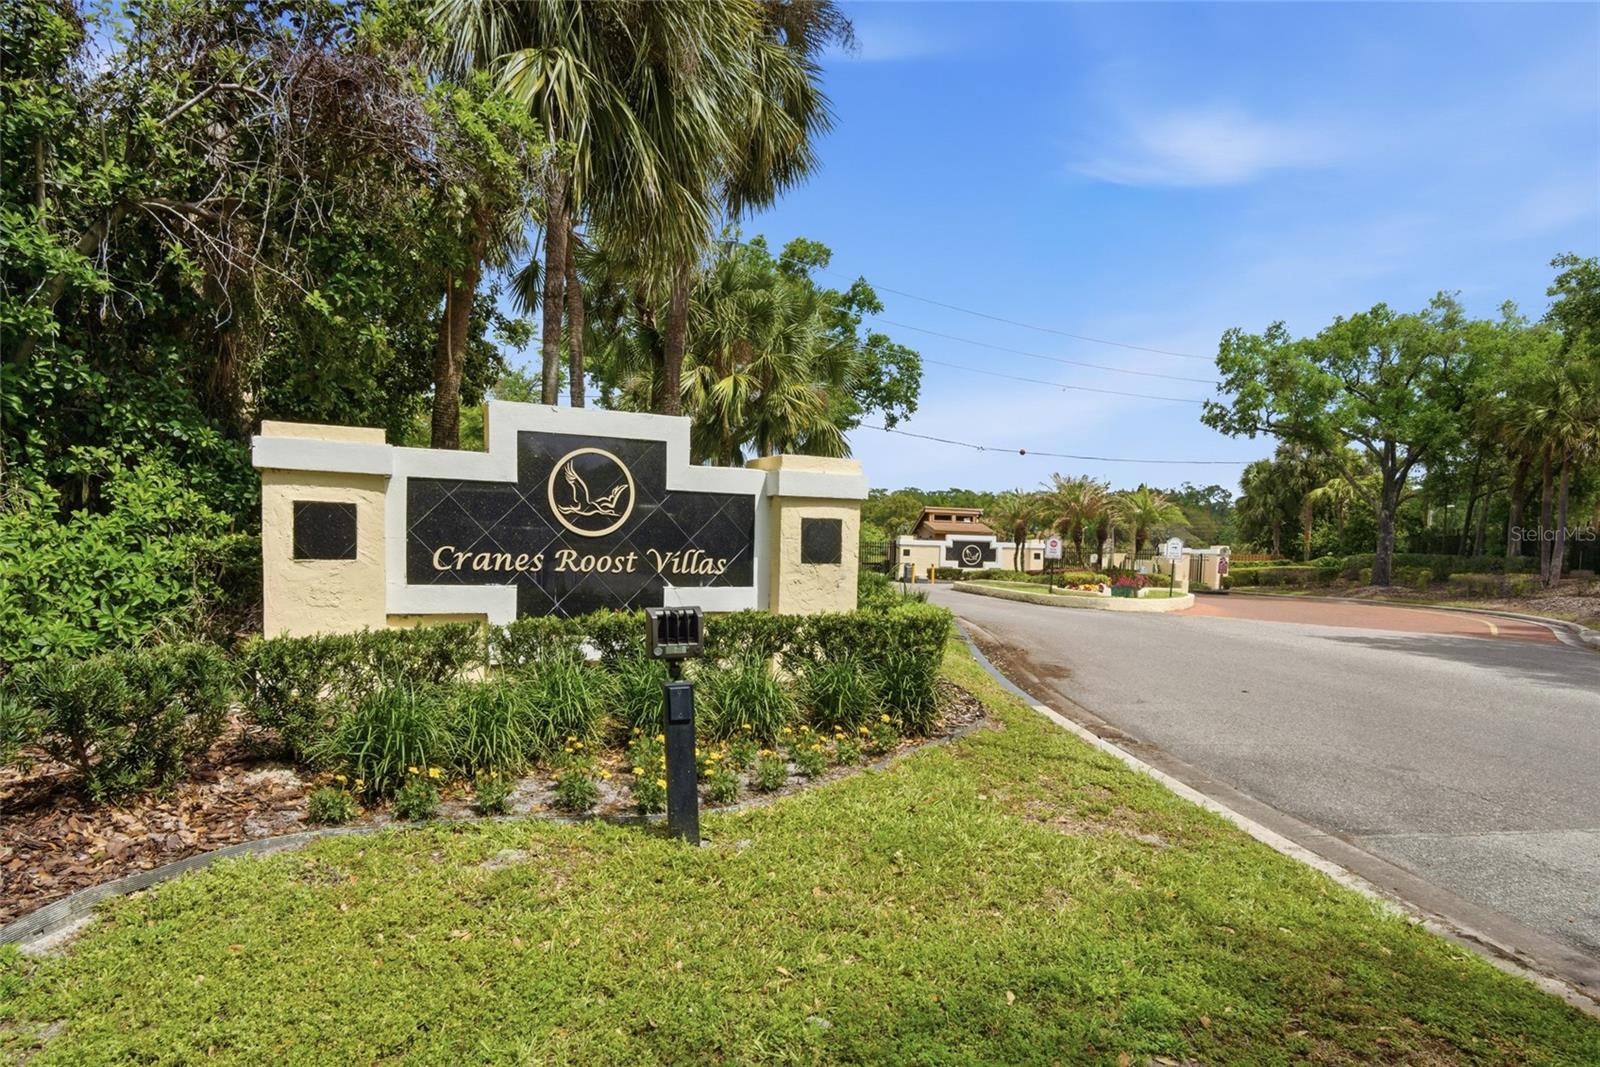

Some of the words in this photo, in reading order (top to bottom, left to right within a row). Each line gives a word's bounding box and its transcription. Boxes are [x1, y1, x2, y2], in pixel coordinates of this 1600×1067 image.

[432, 545, 544, 572] Cranes
[554, 549, 638, 574] Roost
[646, 548, 727, 576] Villas
